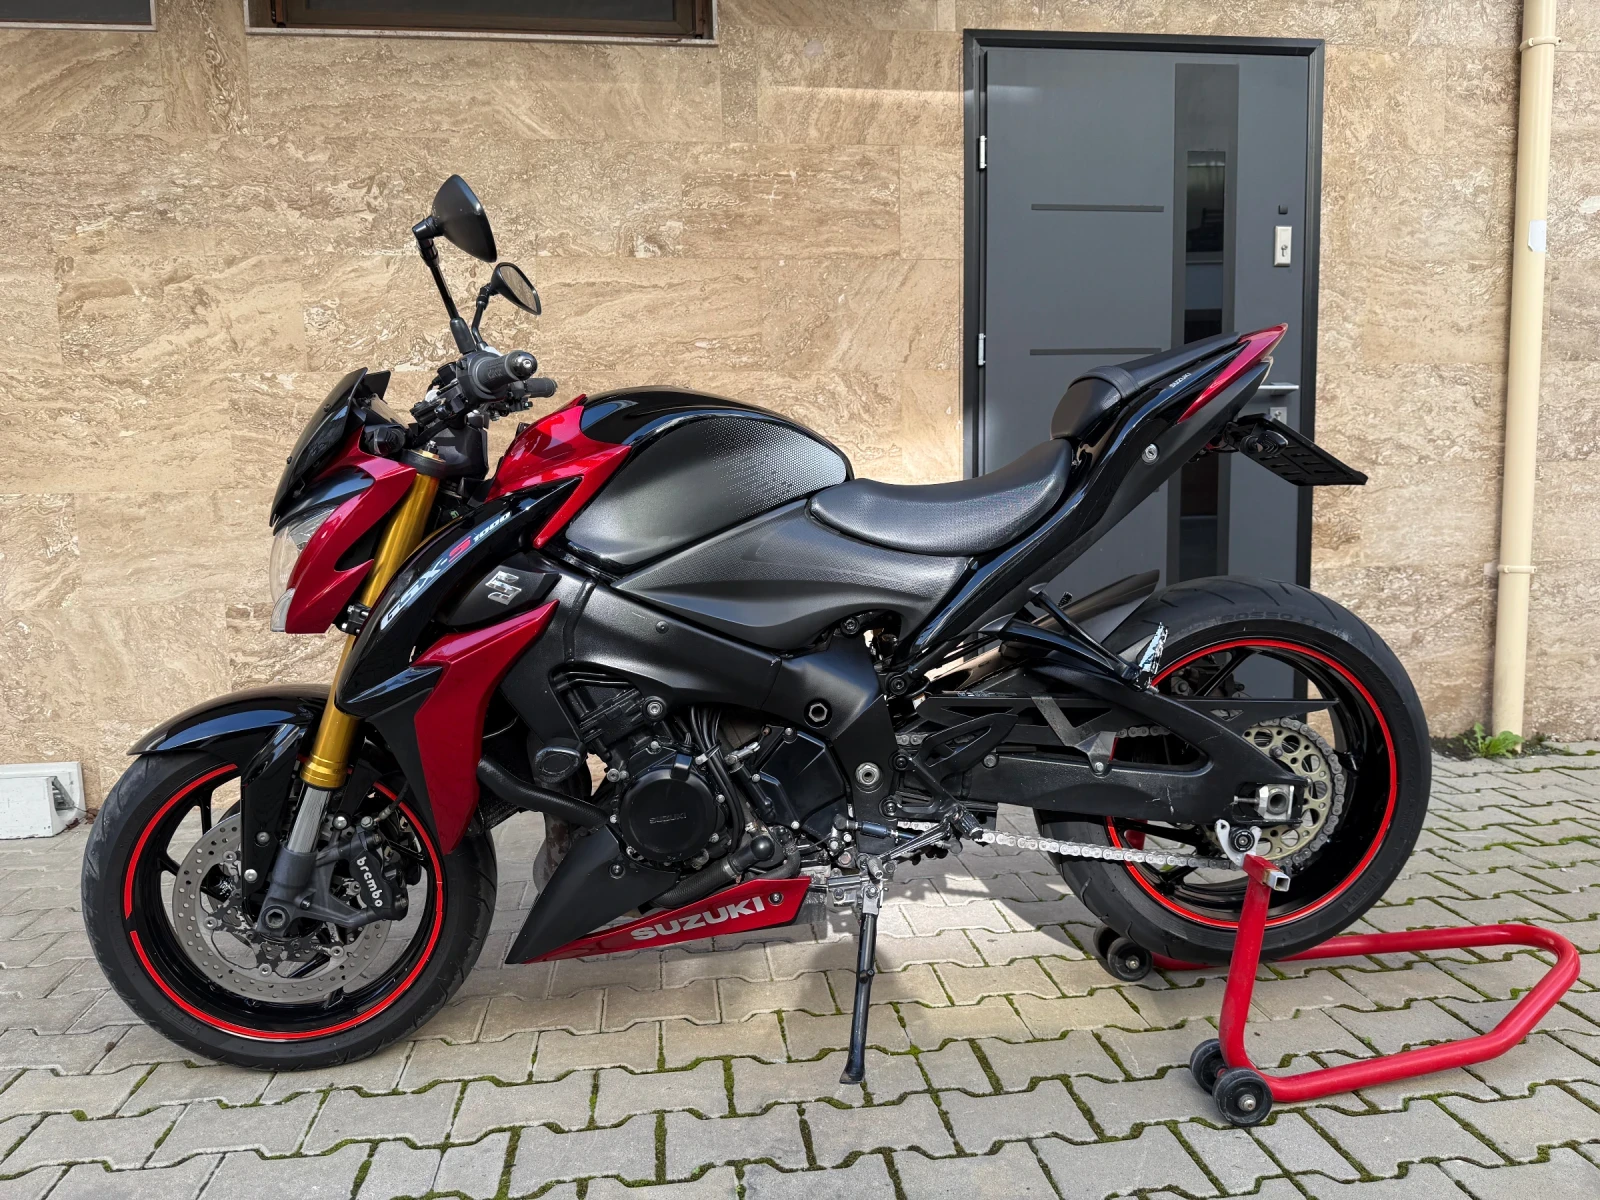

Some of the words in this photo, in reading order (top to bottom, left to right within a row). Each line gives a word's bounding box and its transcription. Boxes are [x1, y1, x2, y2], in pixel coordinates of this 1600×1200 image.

[1168, 372, 1192, 389] SUZUKI
[356, 856, 384, 908] brembo
[630, 896, 766, 941] SUZUKI
